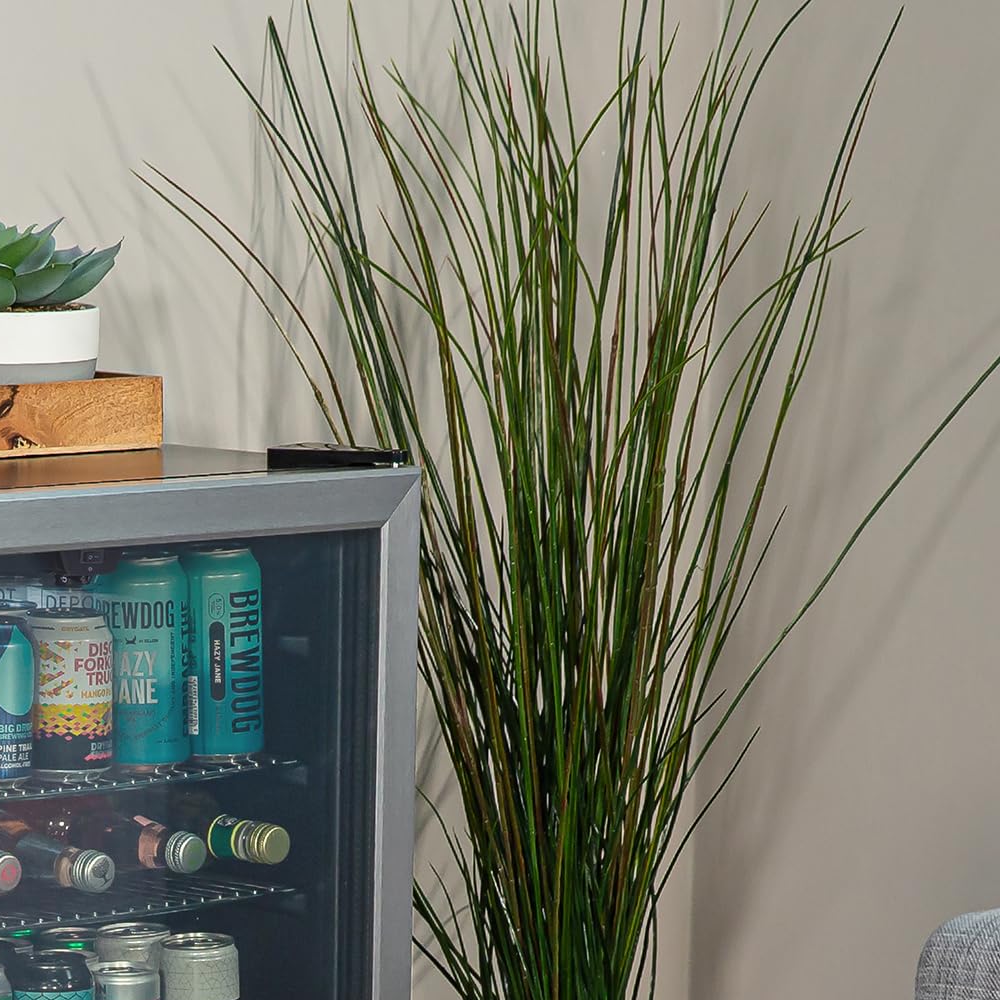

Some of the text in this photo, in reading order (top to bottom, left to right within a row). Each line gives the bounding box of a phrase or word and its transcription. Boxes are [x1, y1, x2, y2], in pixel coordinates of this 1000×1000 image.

[46, 594, 94, 610] DEPO
[118, 651, 159, 677] AZY
[213, 639, 222, 684] HAZY JANE
[229, 589, 262, 734] BREWDOG
[118, 678, 159, 704] ANE
[18, 752, 28, 760] ALE
